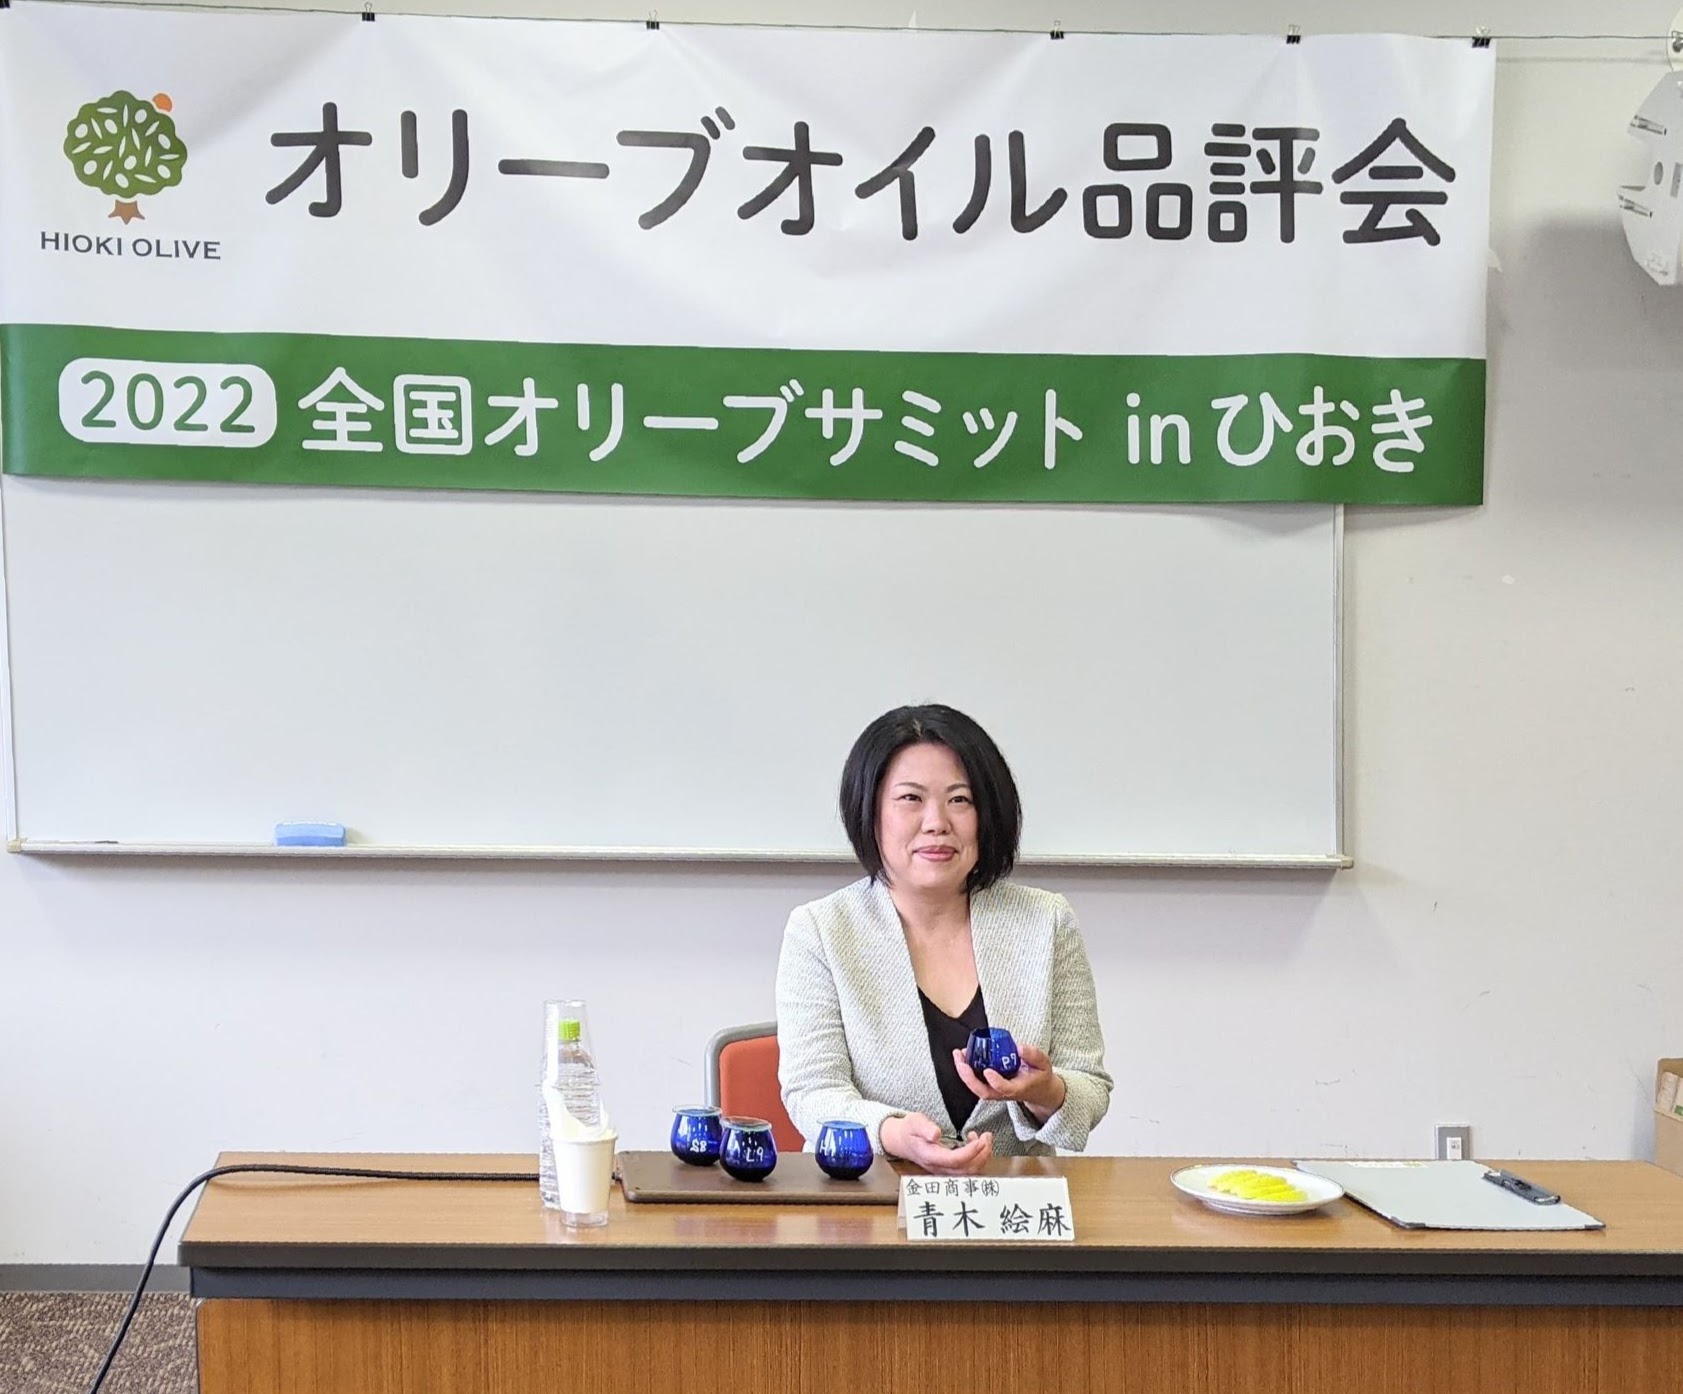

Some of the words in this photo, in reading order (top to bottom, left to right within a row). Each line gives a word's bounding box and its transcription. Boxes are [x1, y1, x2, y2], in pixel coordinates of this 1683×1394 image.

[265, 102, 1456, 247] オリーブオイル品評会
[40, 231, 122, 256] HIOKI
[132, 238, 221, 260] OLIVE
[79, 370, 257, 435] 2022
[297, 366, 1084, 470] 全国オリーブサミット
[1126, 392, 1192, 465] in
[1211, 385, 1433, 473] ひおき
